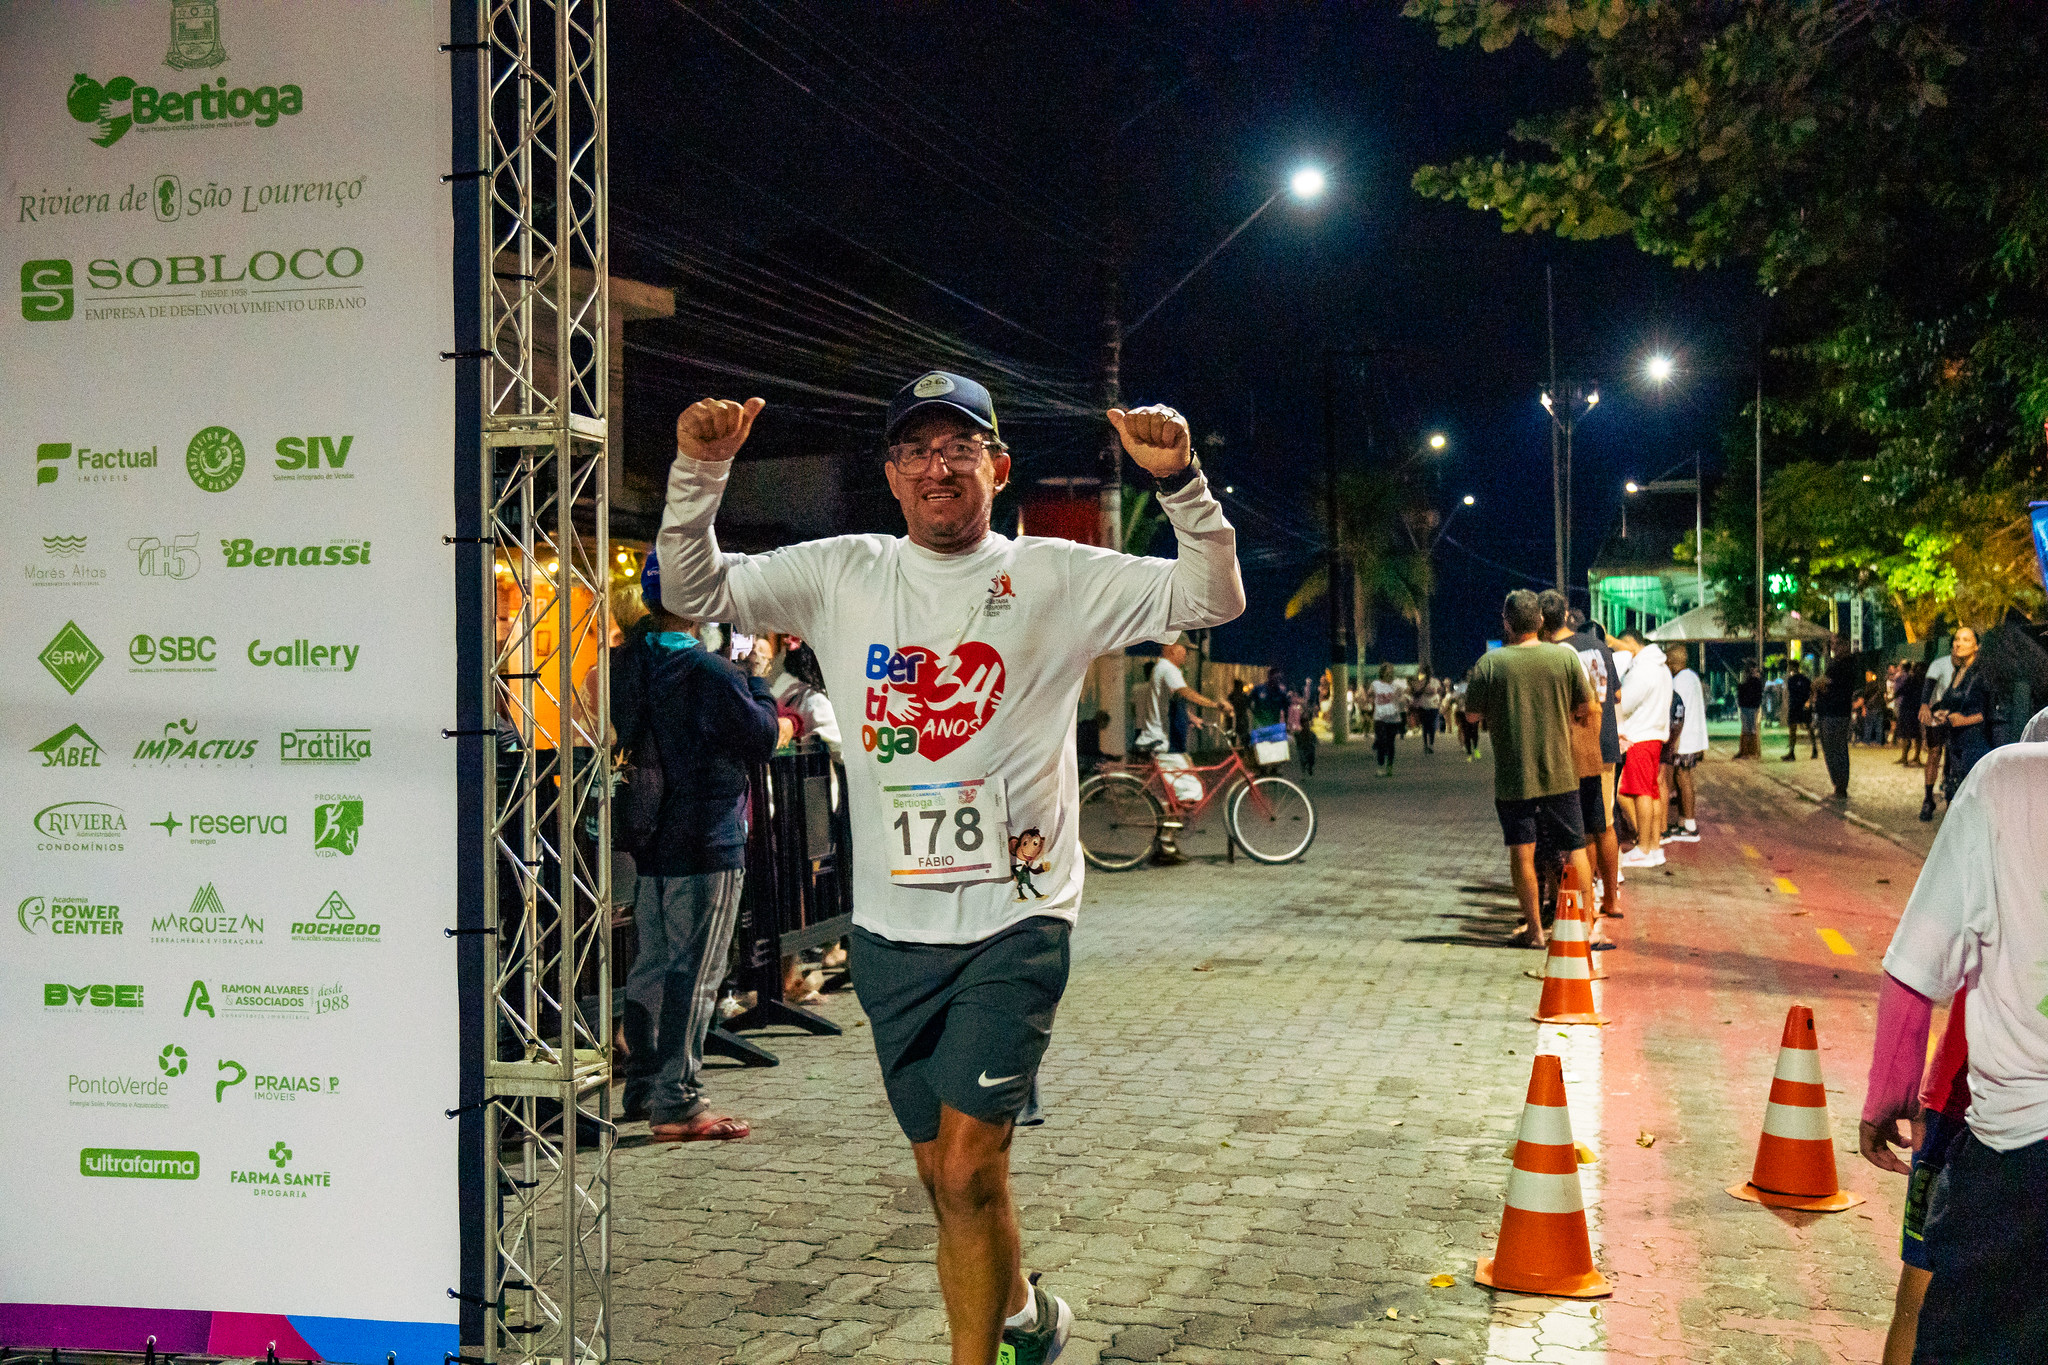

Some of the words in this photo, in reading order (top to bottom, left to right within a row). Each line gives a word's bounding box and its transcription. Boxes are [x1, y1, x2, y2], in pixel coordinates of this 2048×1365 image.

[132, 76, 303, 128] Bertioga
[18, 188, 110, 223] Riviera
[118, 184, 148, 212] de
[187, 182, 233, 217] São
[241, 180, 362, 214] Lourenço
[86, 246, 365, 291] SOBLOCO
[201, 289, 227, 298] DESDE
[85, 306, 147, 321] EMPRESA
[149, 305, 168, 318] DE
[170, 300, 305, 317] DESENVOLVIMENTO
[307, 296, 367, 312] URBANO
[77, 445, 158, 470] Factual
[274, 436, 354, 470] SIV
[226, 538, 371, 568] Benassi
[51, 650, 89, 665] SRW
[159, 635, 217, 662] SBC
[248, 639, 360, 672] Gallery
[865, 643, 925, 684] Ber
[923, 654, 1002, 722] 34
[865, 683, 889, 722] ti
[920, 718, 982, 740] ANOS
[133, 737, 259, 765] IMPACTUS
[281, 733, 372, 758] Prátika
[861, 724, 918, 764] oga
[42, 745, 101, 767] SABEL
[893, 798, 933, 809] Bertioga
[48, 812, 128, 836] RIVIERA
[190, 814, 287, 835] reserva
[893, 806, 984, 856] 178
[37, 841, 125, 852] CONDOMÍNIOS
[190, 838, 217, 846] energia
[315, 850, 338, 858] VIDA
[52, 896, 89, 904] Academia
[51, 904, 120, 920] POWER
[51, 919, 124, 935] CENTER
[221, 984, 261, 994] RAMON
[264, 985, 309, 996] ALVARES
[318, 981, 343, 997] desde
[235, 996, 304, 1007] ASSOCIADOS
[315, 994, 350, 1015] 1988
[69, 1074, 168, 1096] PontoVerde
[255, 1075, 321, 1092] PRAIAS
[254, 1092, 295, 1101] IMÓVEIS
[89, 1154, 195, 1175] ultrafarma
[230, 1171, 281, 1185] FARMA
[254, 1188, 307, 1198] DROGARIA
